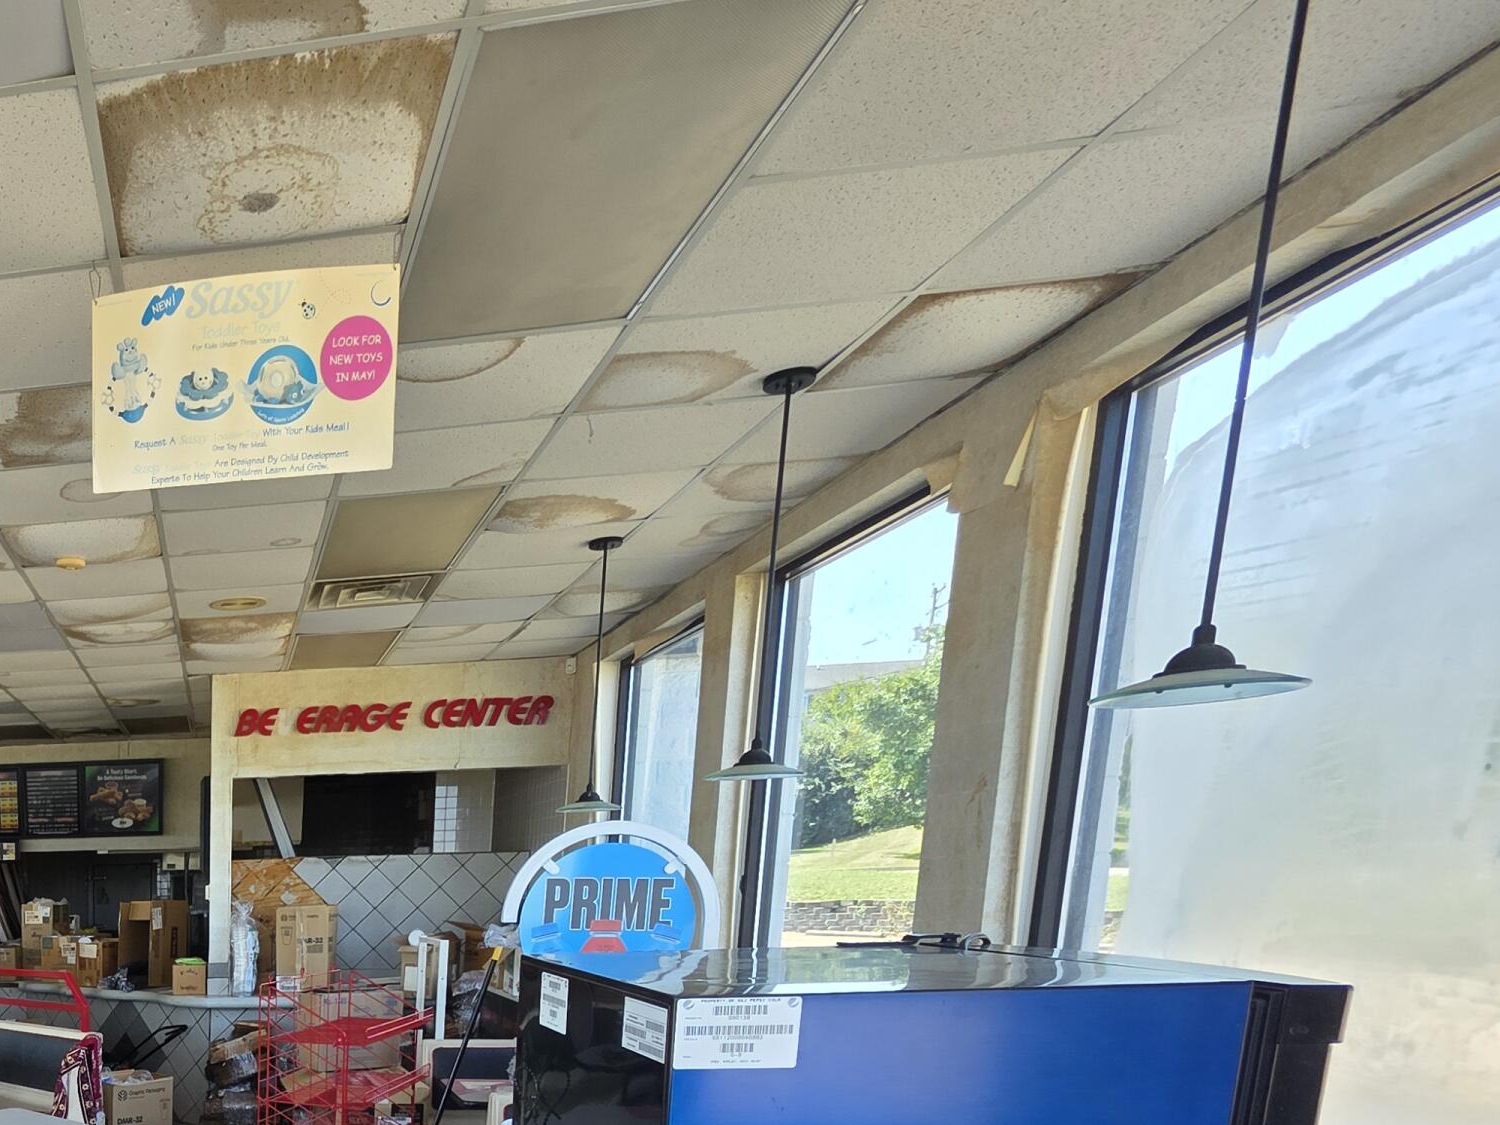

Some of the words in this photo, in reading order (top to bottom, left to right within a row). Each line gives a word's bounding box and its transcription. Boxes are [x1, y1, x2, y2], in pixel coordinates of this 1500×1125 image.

[151, 294, 176, 315] NEW!
[185, 278, 294, 320] Sassy
[332, 336, 360, 348] LOOK
[361, 334, 382, 346] FOR
[329, 353, 354, 366] NEW
[356, 352, 383, 364] TOYS
[335, 371, 349, 383] IN
[351, 370, 376, 382] MAY!
[133, 438, 166, 451] Request
[169, 437, 177, 446] A
[262, 428, 282, 437] With
[285, 426, 303, 436] Your
[305, 424, 324, 434] Kids
[231, 456, 265, 467] Designed
[267, 454, 278, 465] By
[280, 451, 299, 462] Child
[301, 449, 349, 463] Development
[151, 474, 180, 486] Experts
[182, 473, 192, 481] To
[194, 471, 211, 482] Help
[212, 469, 230, 479] Your
[232, 465, 262, 477] Children
[265, 465, 287, 475] Learn
[289, 463, 305, 473] And
[423, 694, 555, 729] CENTER
[543, 876, 676, 932] PRIME
